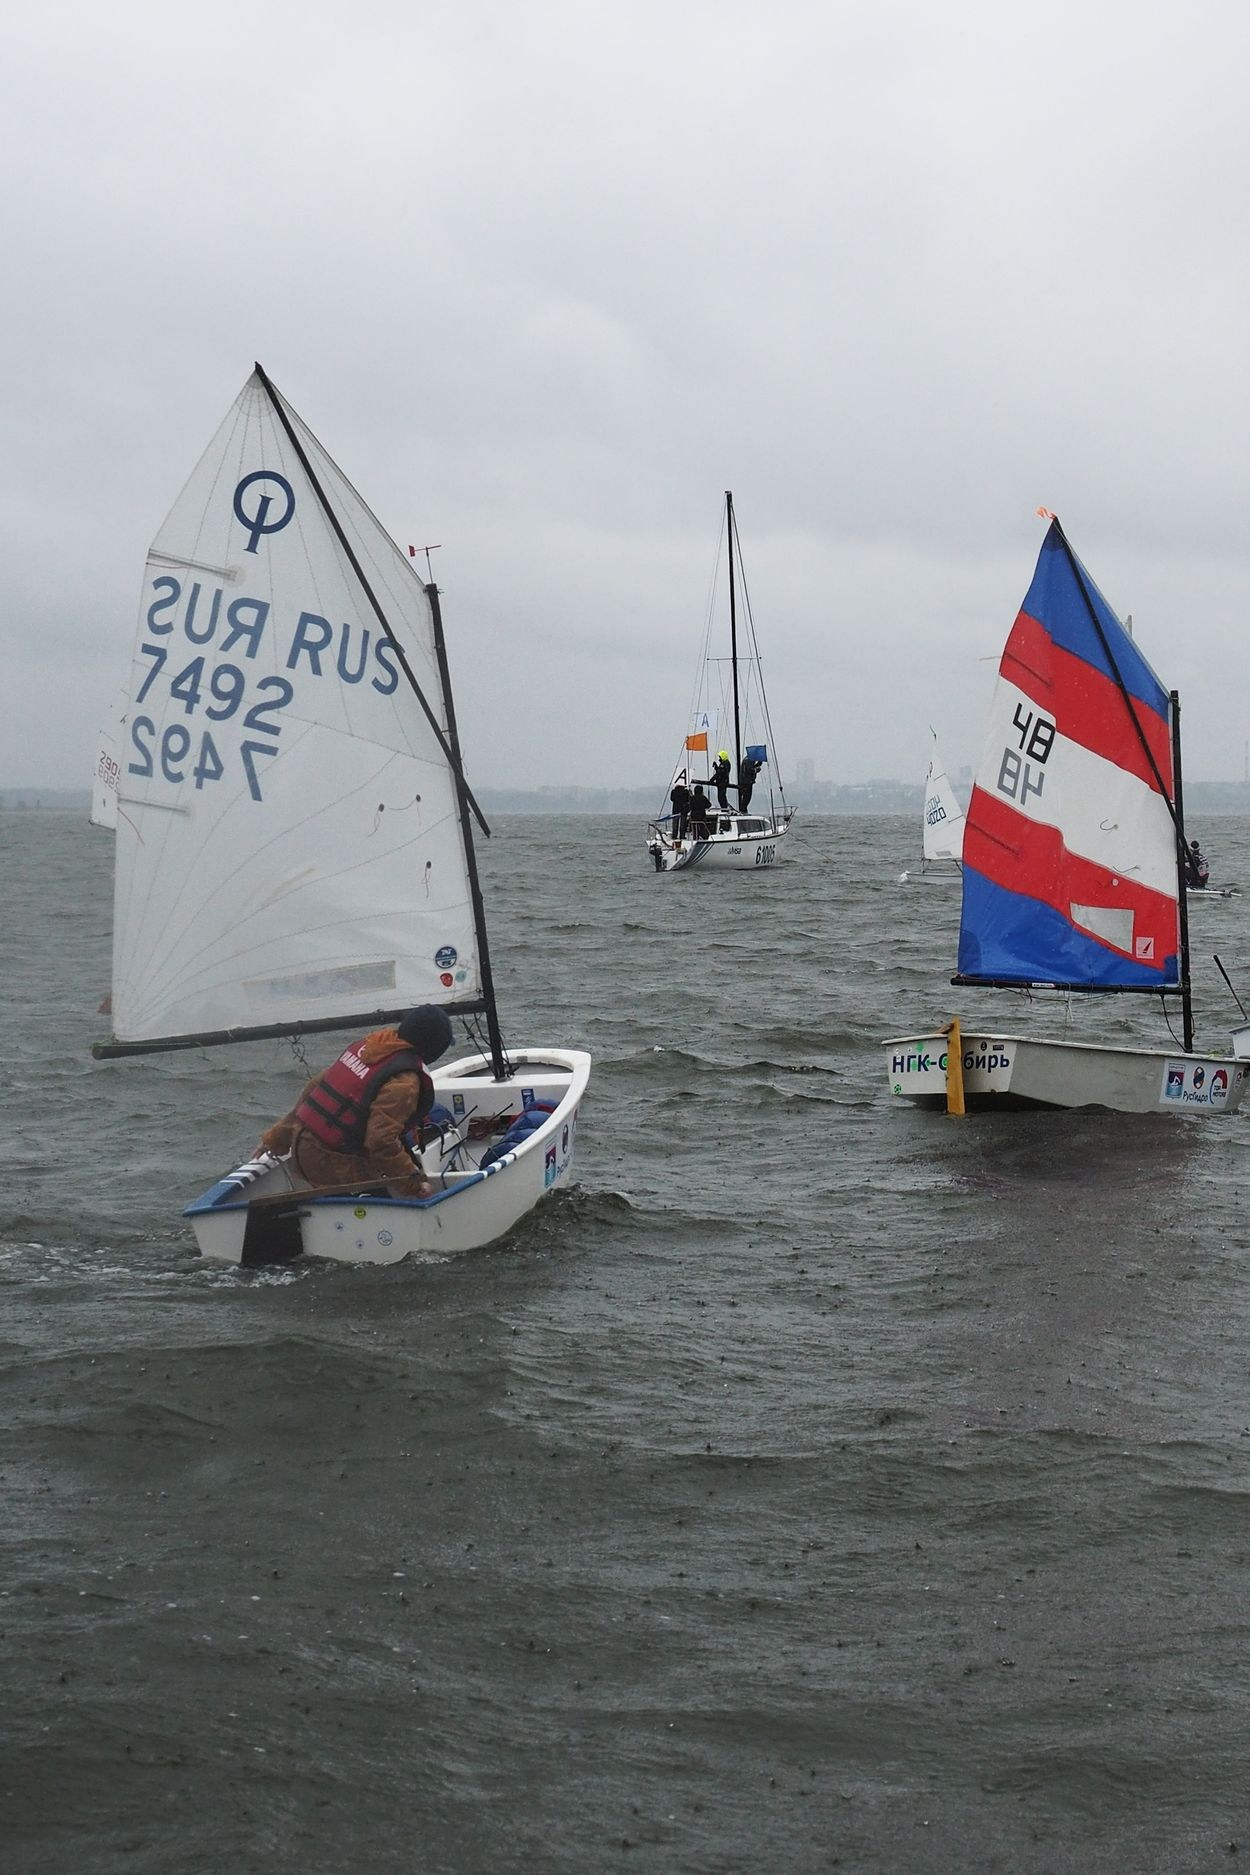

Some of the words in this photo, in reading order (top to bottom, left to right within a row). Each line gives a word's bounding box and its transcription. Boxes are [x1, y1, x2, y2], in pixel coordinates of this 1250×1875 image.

[286, 611, 405, 696] RUS
[134, 643, 294, 736] 7492
[1012, 702, 1057, 765] 48
[674, 768, 687, 785] A
[339, 1050, 370, 1079] YAMAHA
[892, 1050, 1010, 1073] НГК-Сбирь
